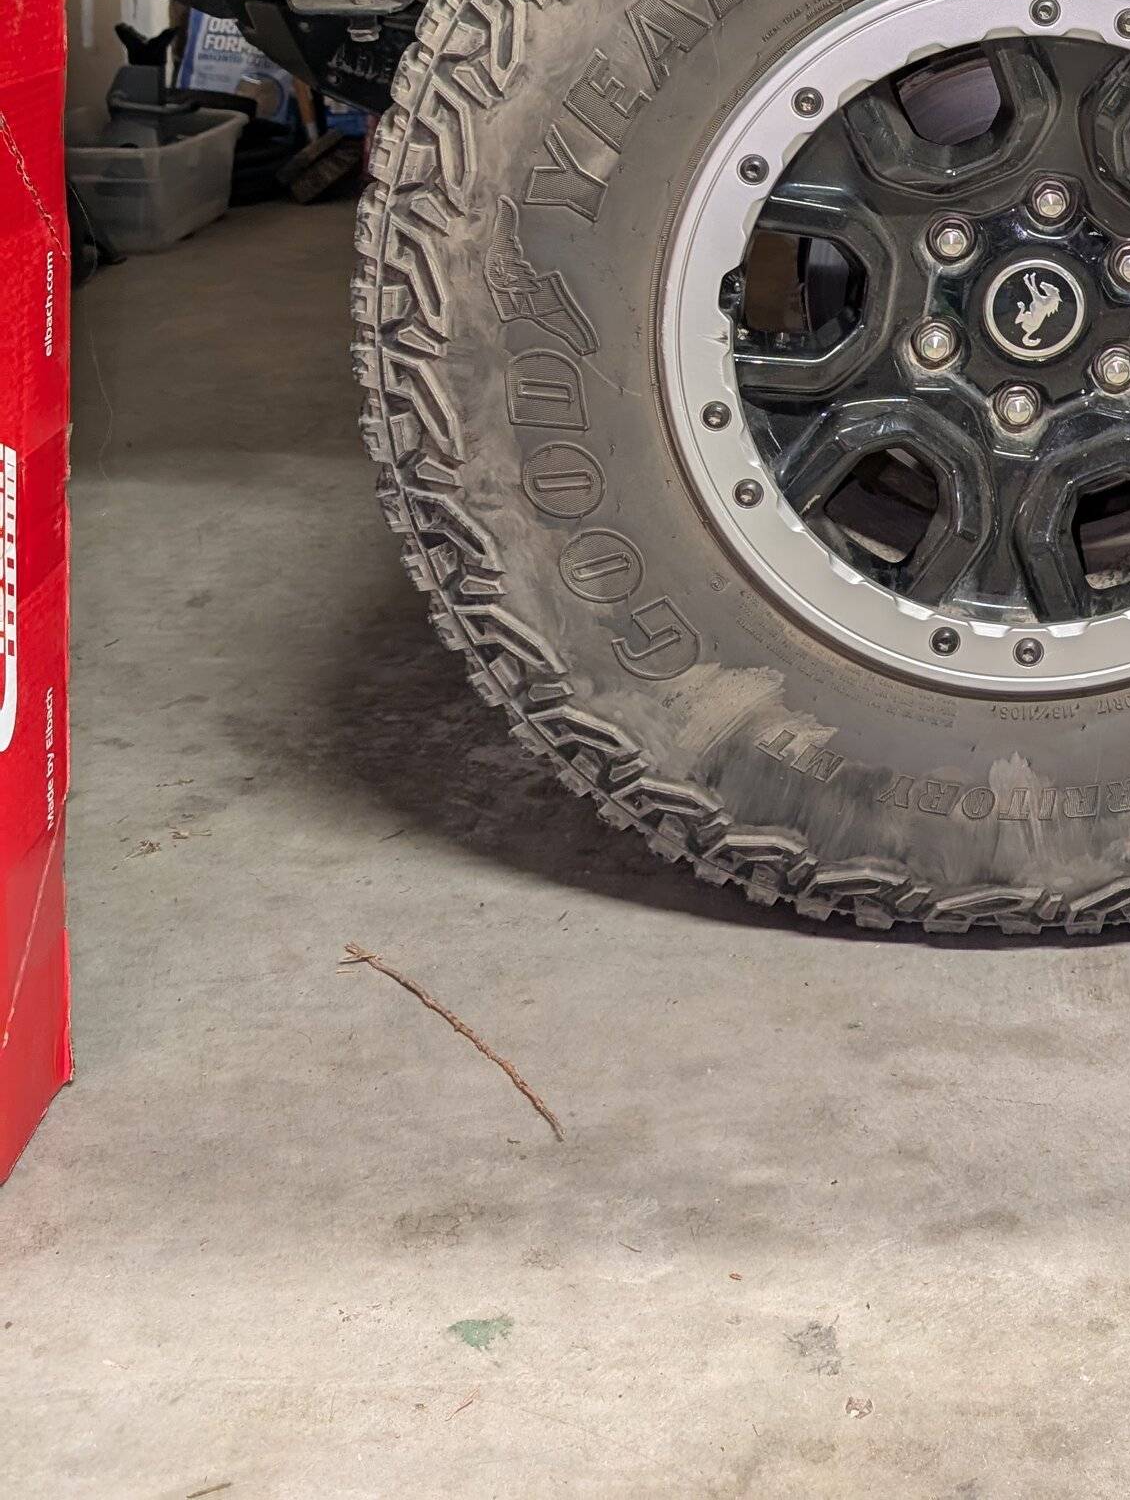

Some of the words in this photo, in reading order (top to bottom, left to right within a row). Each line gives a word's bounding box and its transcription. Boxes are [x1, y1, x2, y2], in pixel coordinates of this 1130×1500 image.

[44, 251, 53, 357] eibach.com
[45, 686, 53, 750] Eibach
[46, 752, 54, 778] by
[757, 728, 844, 783] MT
[46, 779, 54, 831] Made
